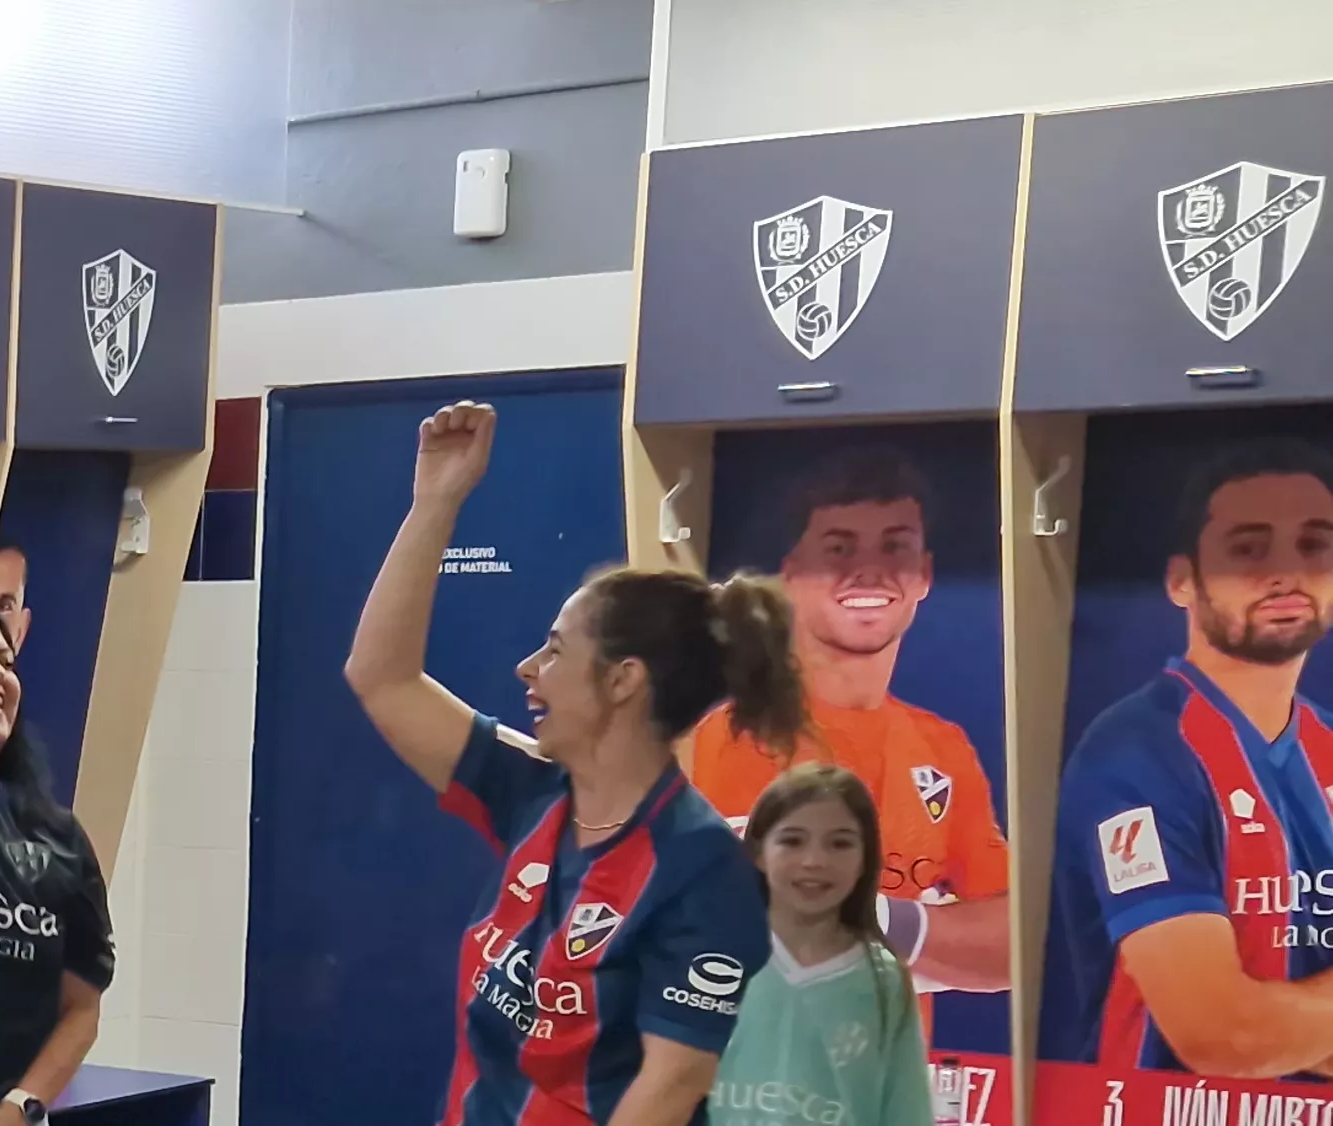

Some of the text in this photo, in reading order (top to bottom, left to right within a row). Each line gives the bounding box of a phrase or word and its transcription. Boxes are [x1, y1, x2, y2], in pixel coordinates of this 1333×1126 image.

[775, 222, 881, 302] S.D. HUESCA
[1183, 189, 1312, 279] S.D. HUESCA
[460, 561, 512, 573] MATERIAL
